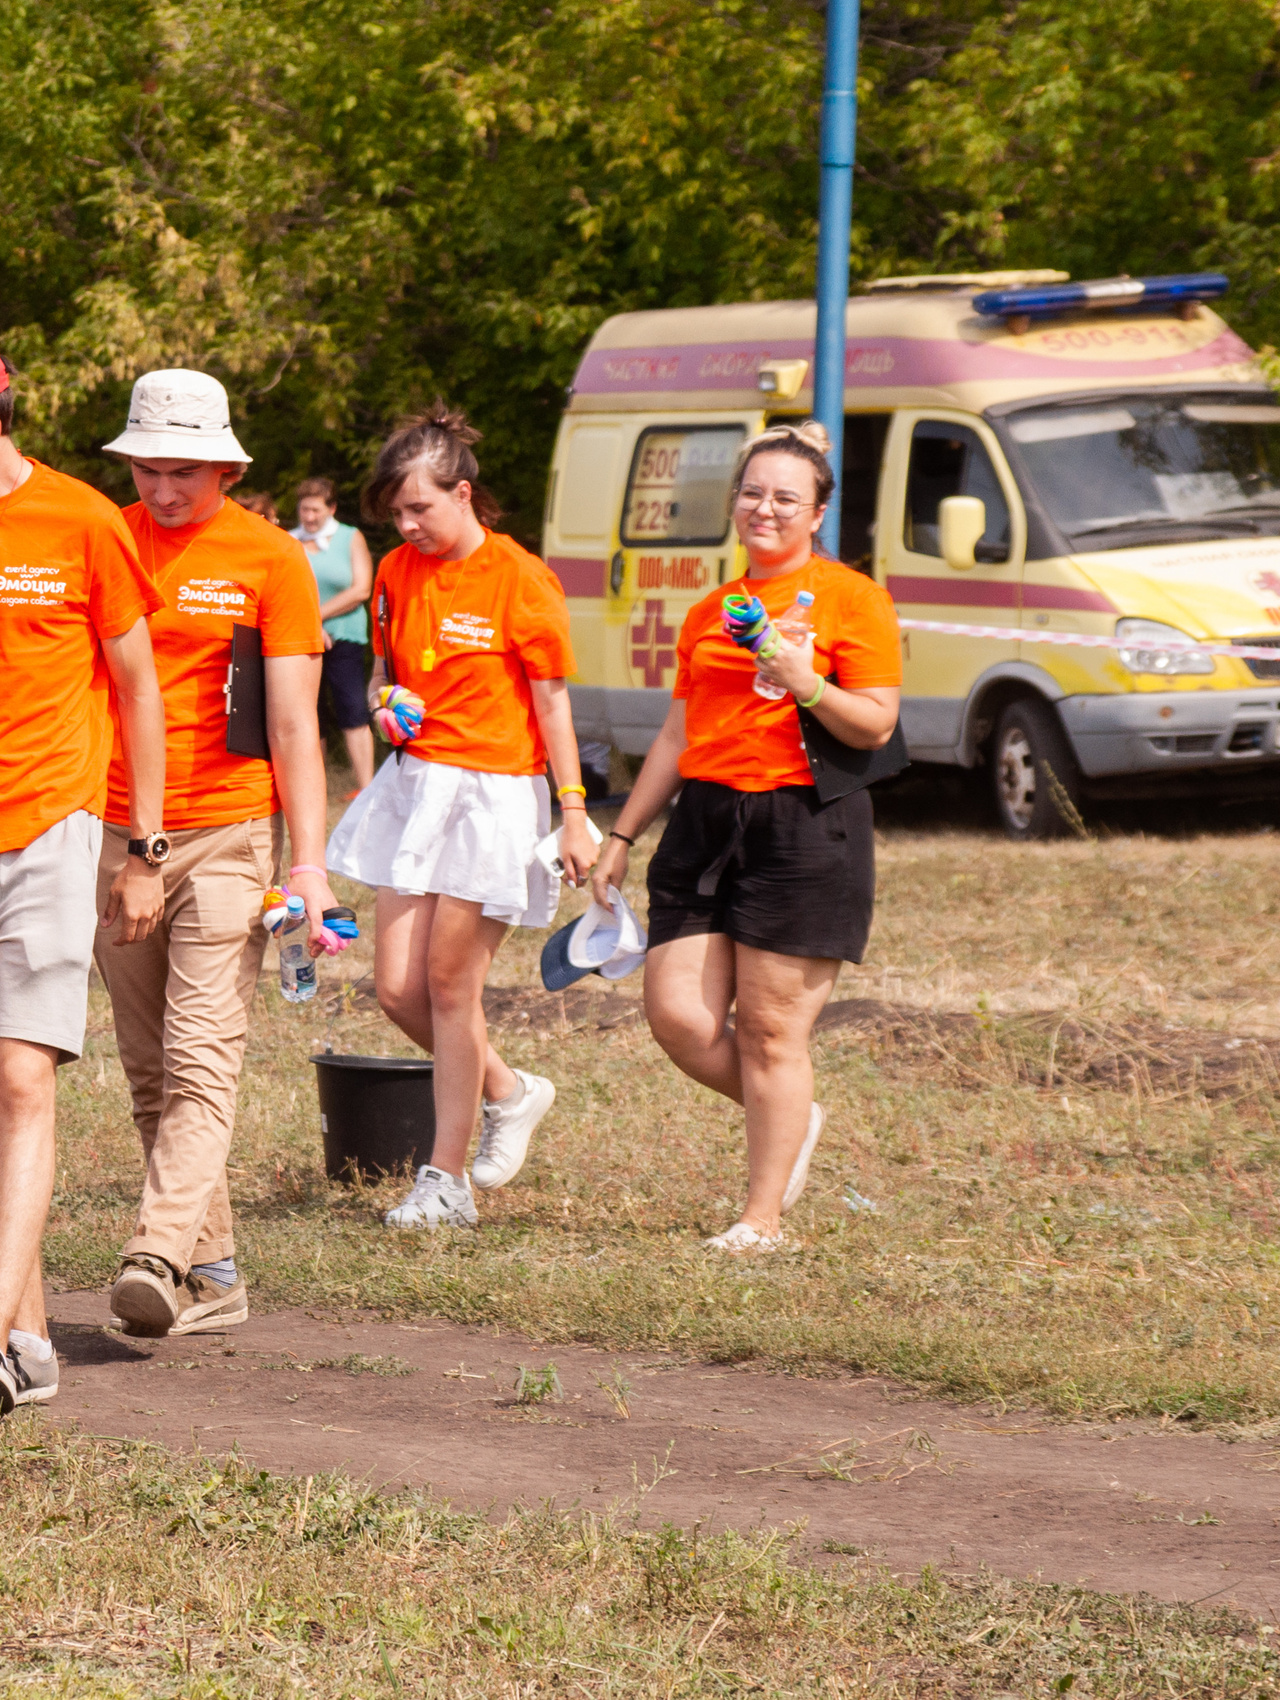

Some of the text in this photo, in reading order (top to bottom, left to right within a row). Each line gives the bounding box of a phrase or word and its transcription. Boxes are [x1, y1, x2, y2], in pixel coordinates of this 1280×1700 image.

[1041, 326, 1191, 352] 500-911
[4, 564, 60, 577] event agency
[177, 585, 246, 605] Эмоция
[440, 618, 495, 639] Эмоция
